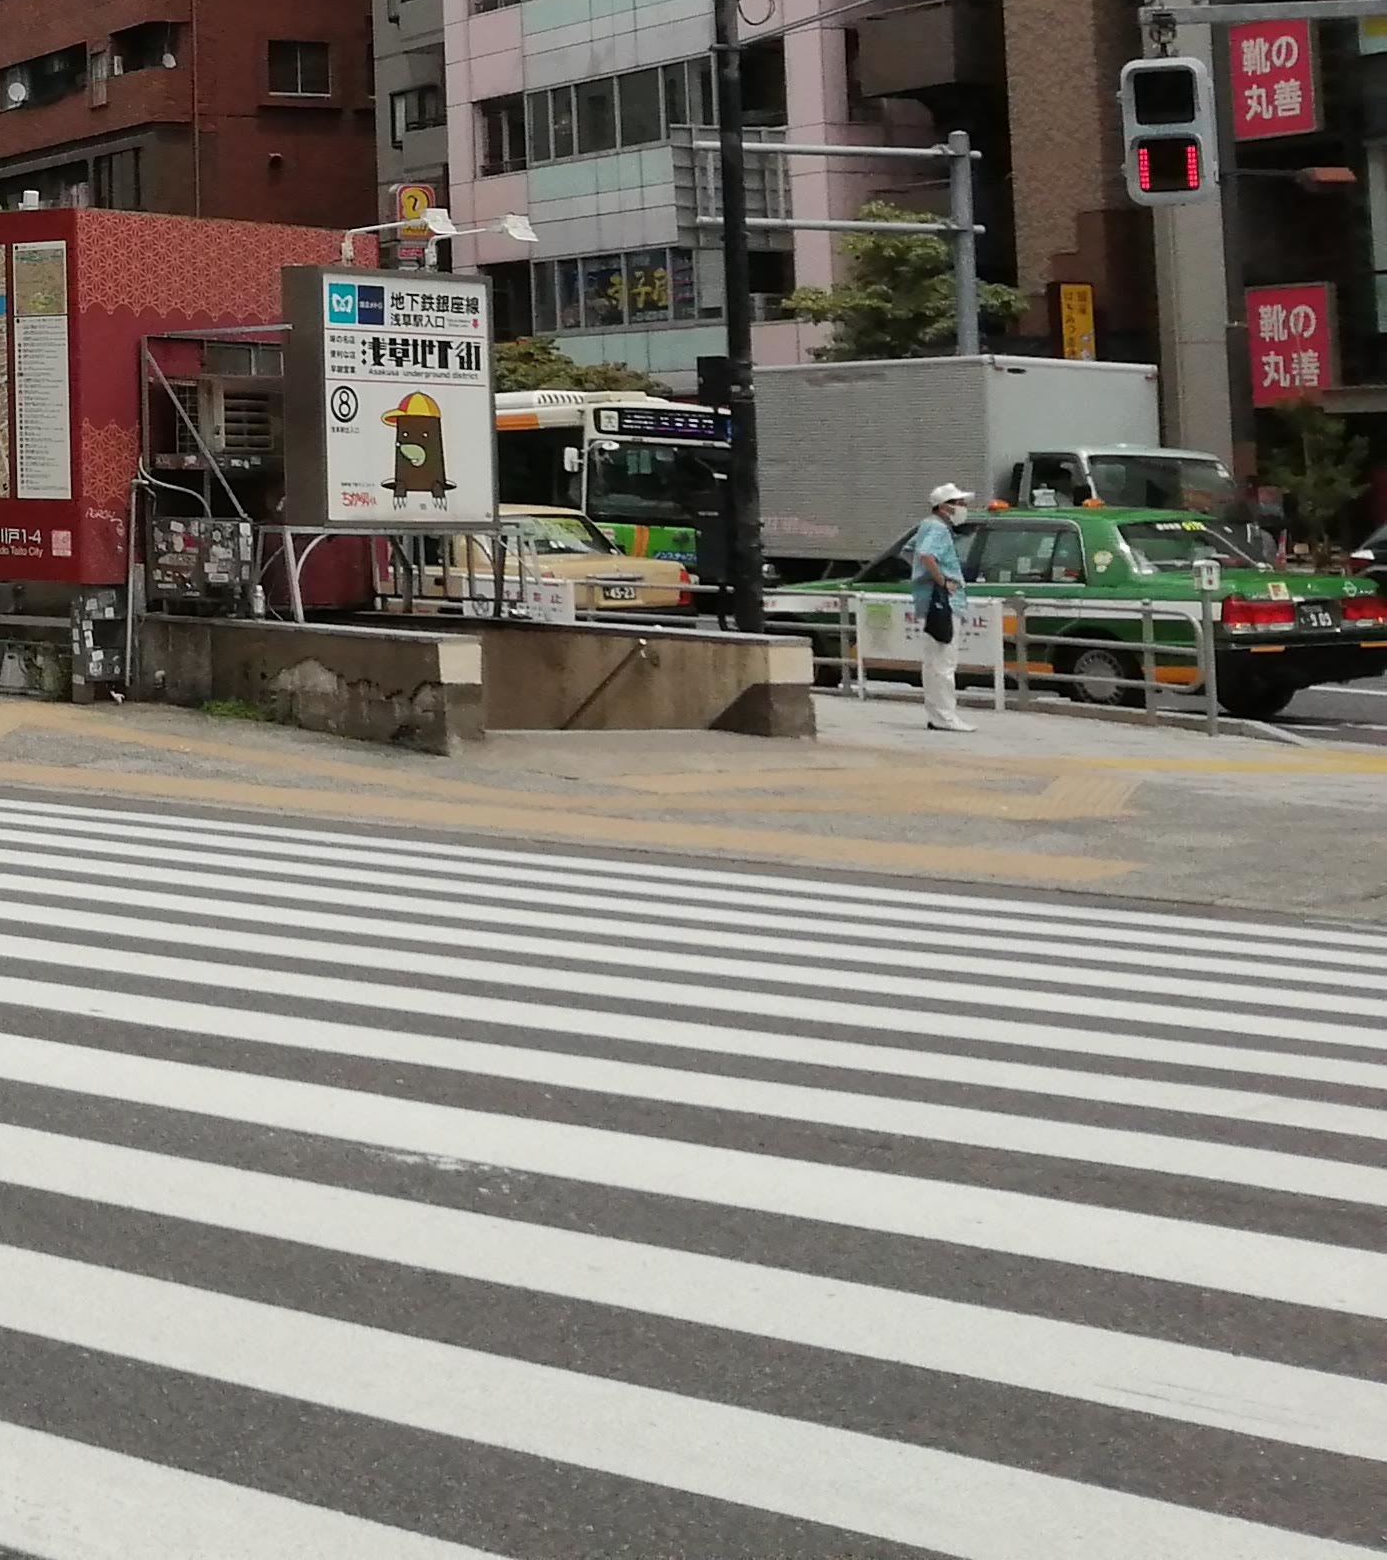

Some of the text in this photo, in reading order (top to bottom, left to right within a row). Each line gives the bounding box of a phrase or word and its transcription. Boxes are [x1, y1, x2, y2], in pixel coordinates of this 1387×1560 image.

[1241, 34, 1299, 77] 靴の
[1244, 75, 1303, 121] 丸善
[390, 292, 480, 315] 地下鉄銀座線
[390, 313, 445, 329] 浅草駅入口
[1258, 302, 1317, 343] 靴の
[367, 336, 481, 371] 浅草地下街
[1261, 350, 1321, 388] 丸善
[368, 368, 478, 380] Asakusa underground district
[11, 546, 27, 557] Taito
[28, 546, 44, 558] City
